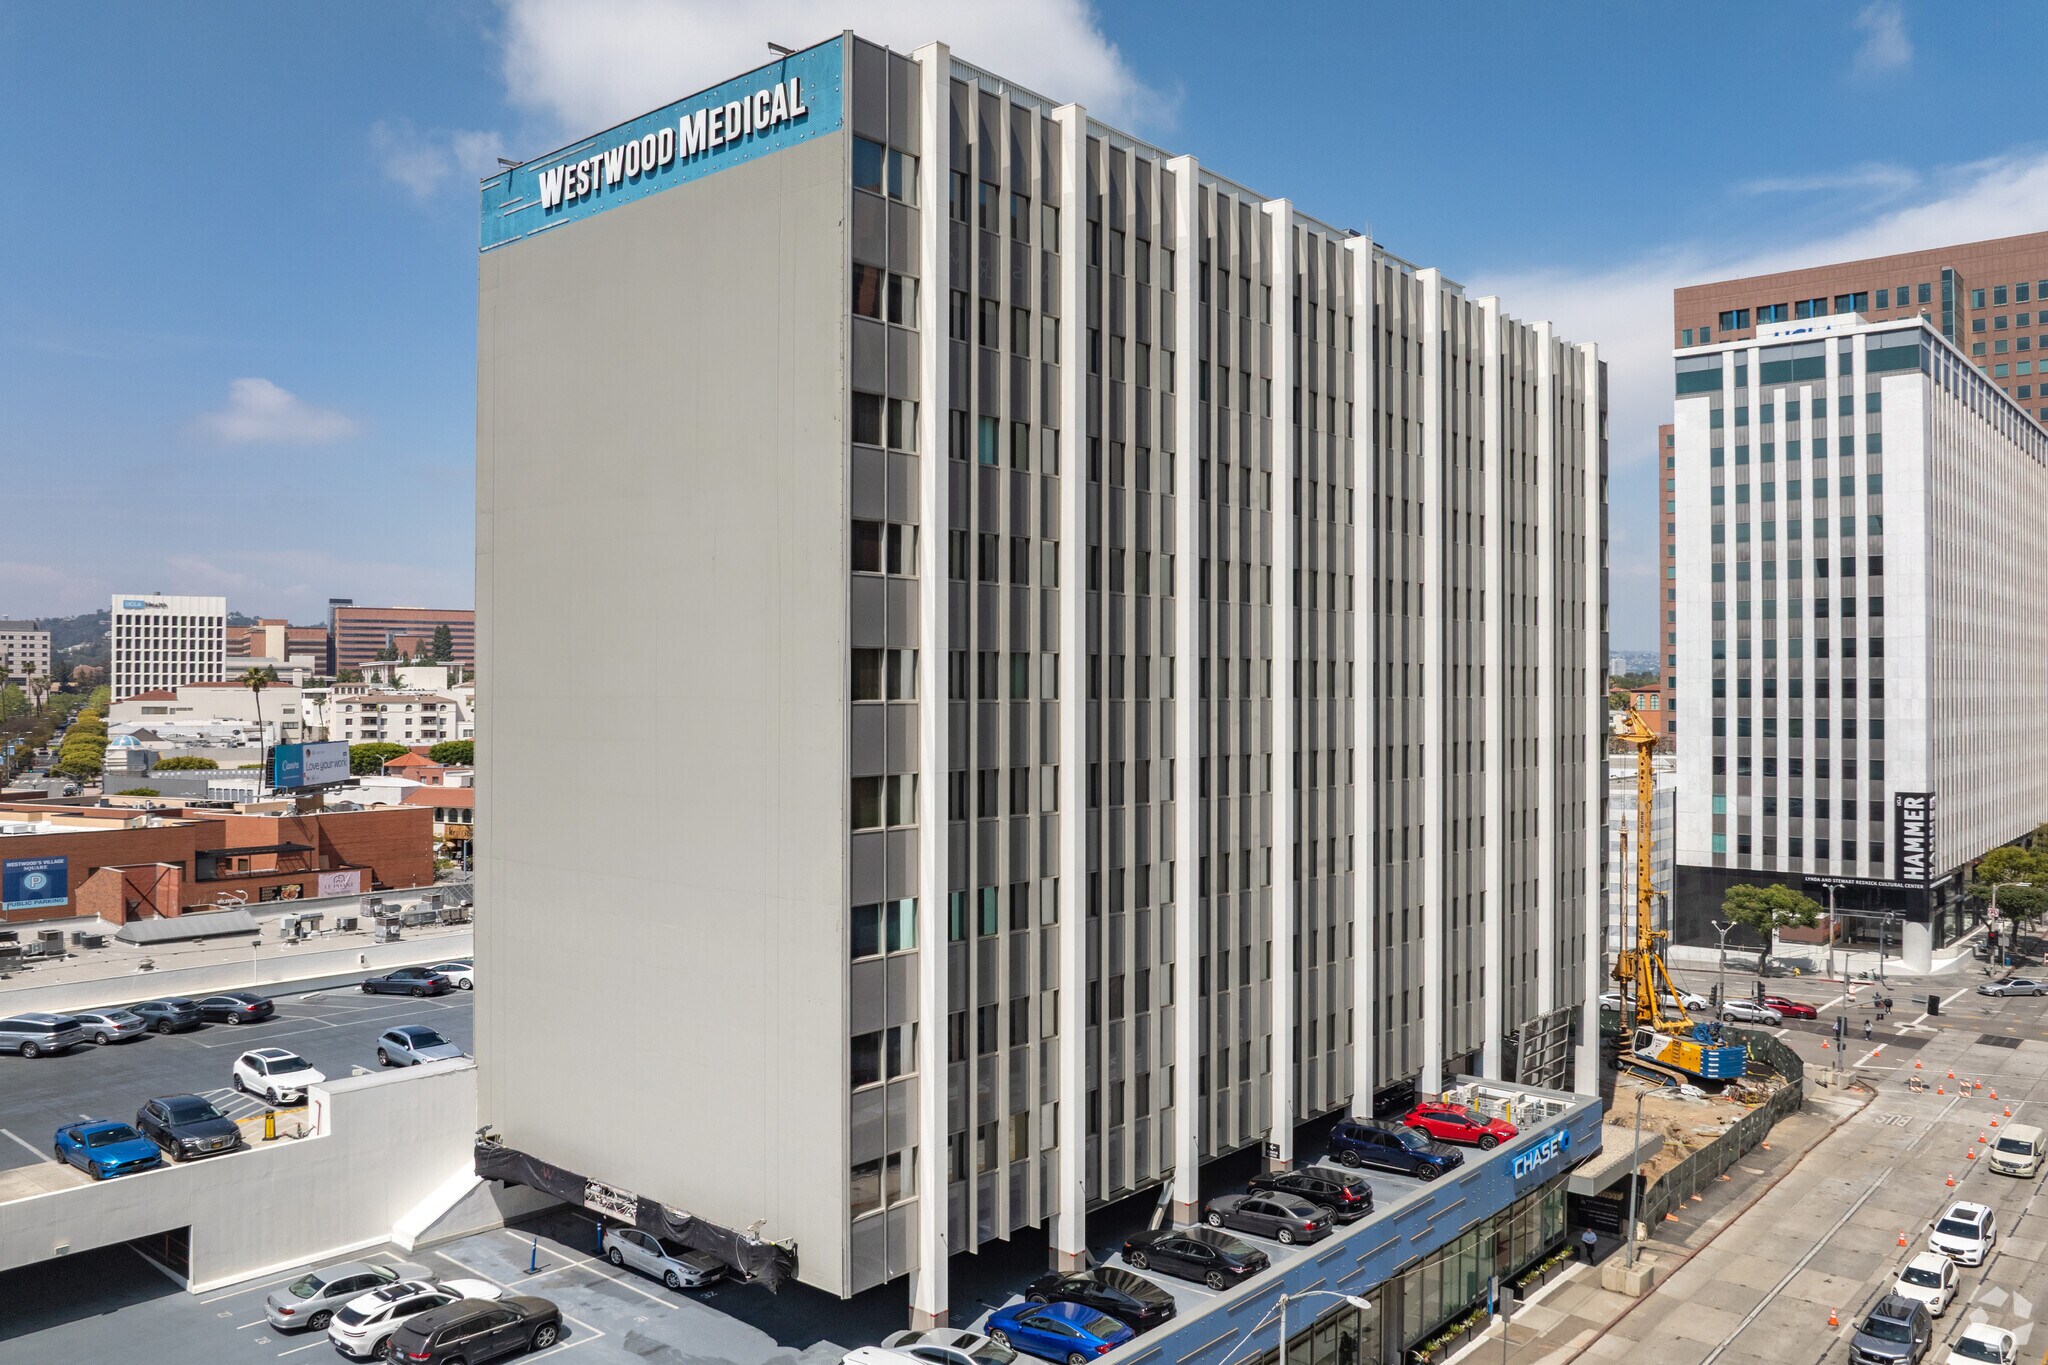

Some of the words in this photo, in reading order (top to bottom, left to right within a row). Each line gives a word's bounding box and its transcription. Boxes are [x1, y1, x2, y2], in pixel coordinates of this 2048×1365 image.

[539, 127, 677, 209] WESTWOOD
[679, 77, 808, 158] MEDICAL
[282, 760, 300, 772] Canva
[305, 761, 319, 772] Love
[320, 760, 334, 772] your
[334, 758, 347, 768] work
[1903, 796, 1925, 880] HAMMER
[6, 860, 42, 868] WESTWOOD'S
[30, 876, 42, 888] P
[34, 897, 64, 905] PARKING
[1875, 1112, 1913, 1127] BUS
[1514, 1135, 1559, 1180] CHASE
